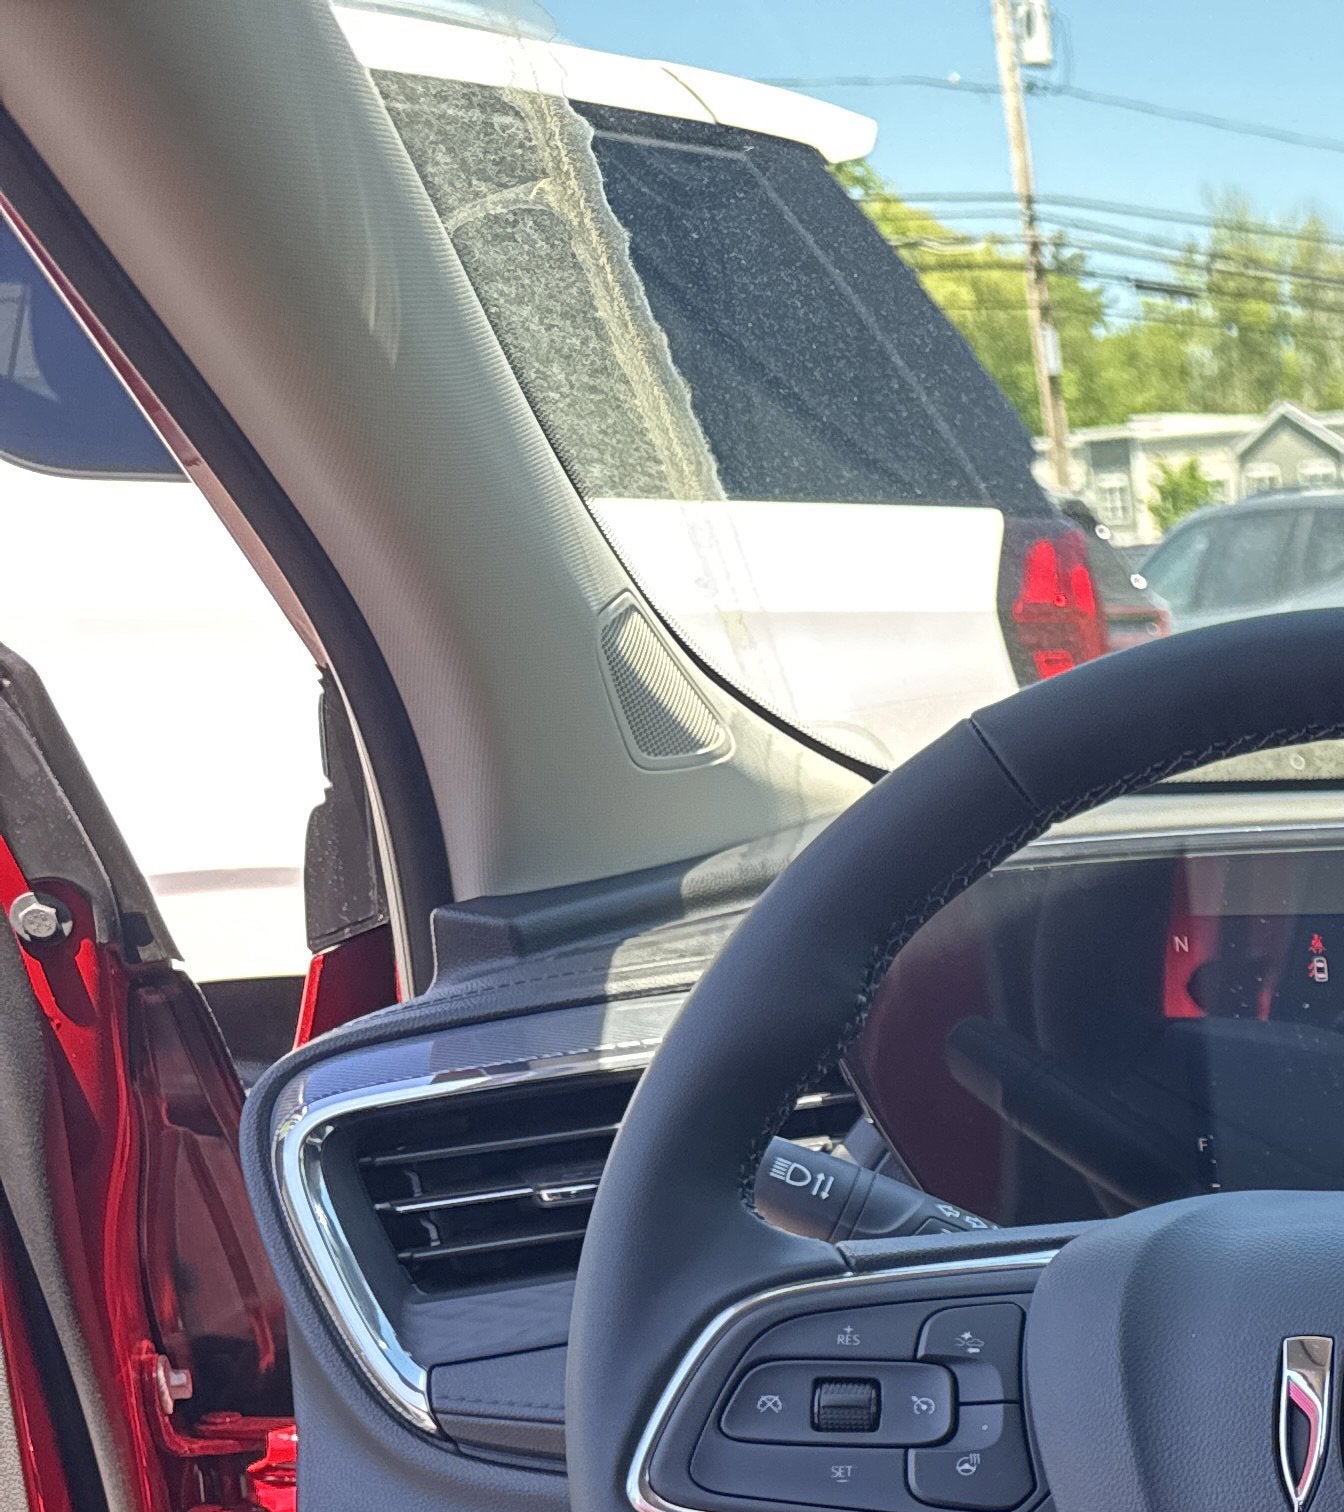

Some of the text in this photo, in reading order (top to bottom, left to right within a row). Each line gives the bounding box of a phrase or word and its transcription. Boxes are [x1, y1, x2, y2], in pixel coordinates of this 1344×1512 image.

[1173, 935, 1190, 953] N
[1198, 1137, 1208, 1152] F
[837, 1333, 861, 1346] RES
[831, 1465, 853, 1479] SET
